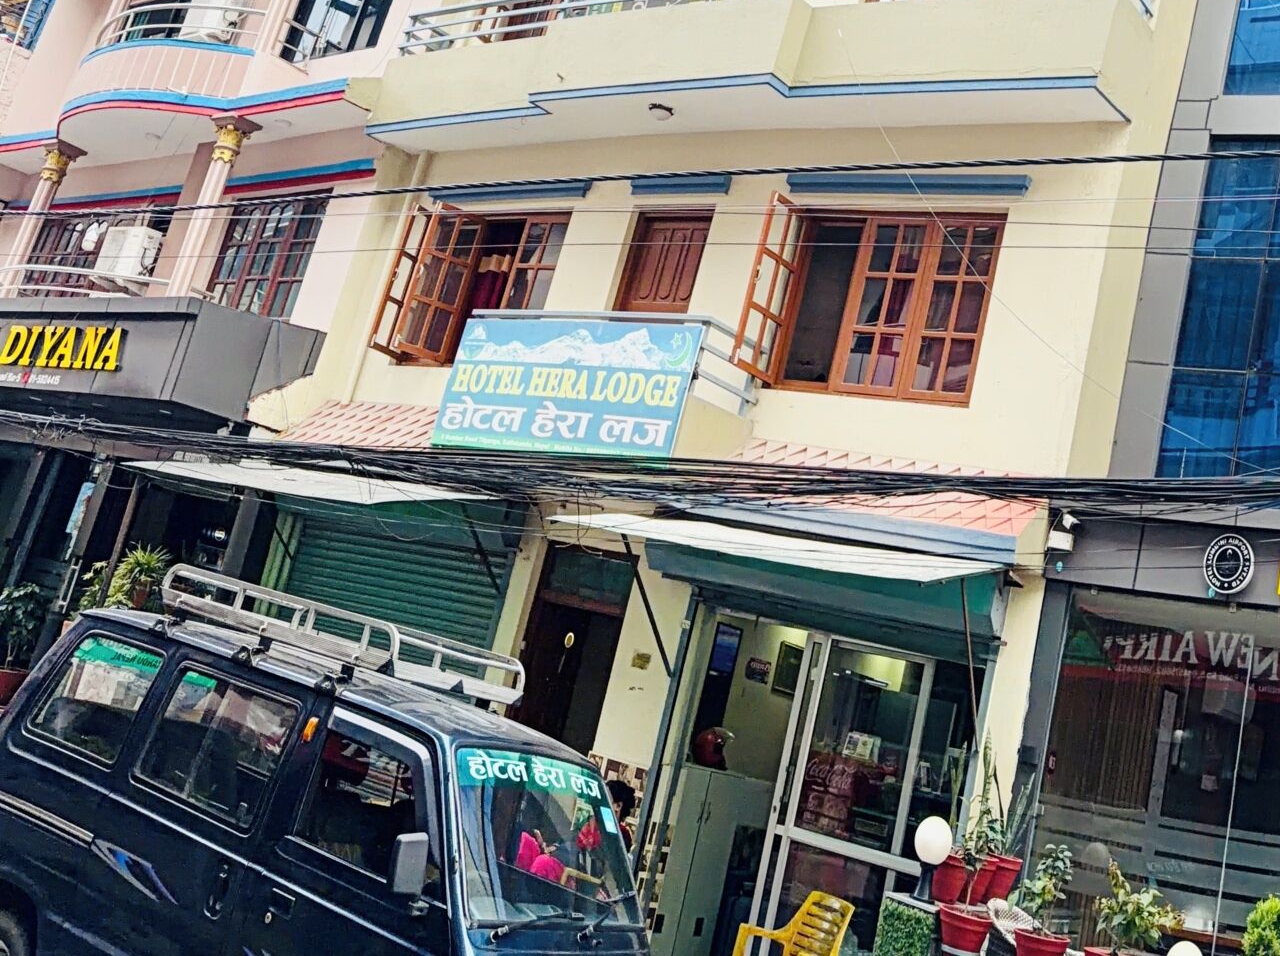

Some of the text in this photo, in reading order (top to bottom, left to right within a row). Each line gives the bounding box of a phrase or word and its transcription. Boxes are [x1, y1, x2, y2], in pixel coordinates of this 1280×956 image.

[0, 325, 122, 370] DIYANA
[452, 364, 682, 407] HOTEL HERA LODGE
[441, 396, 673, 447] होटल हेरा लज
[467, 752, 602, 799] होटल हेरा लज
